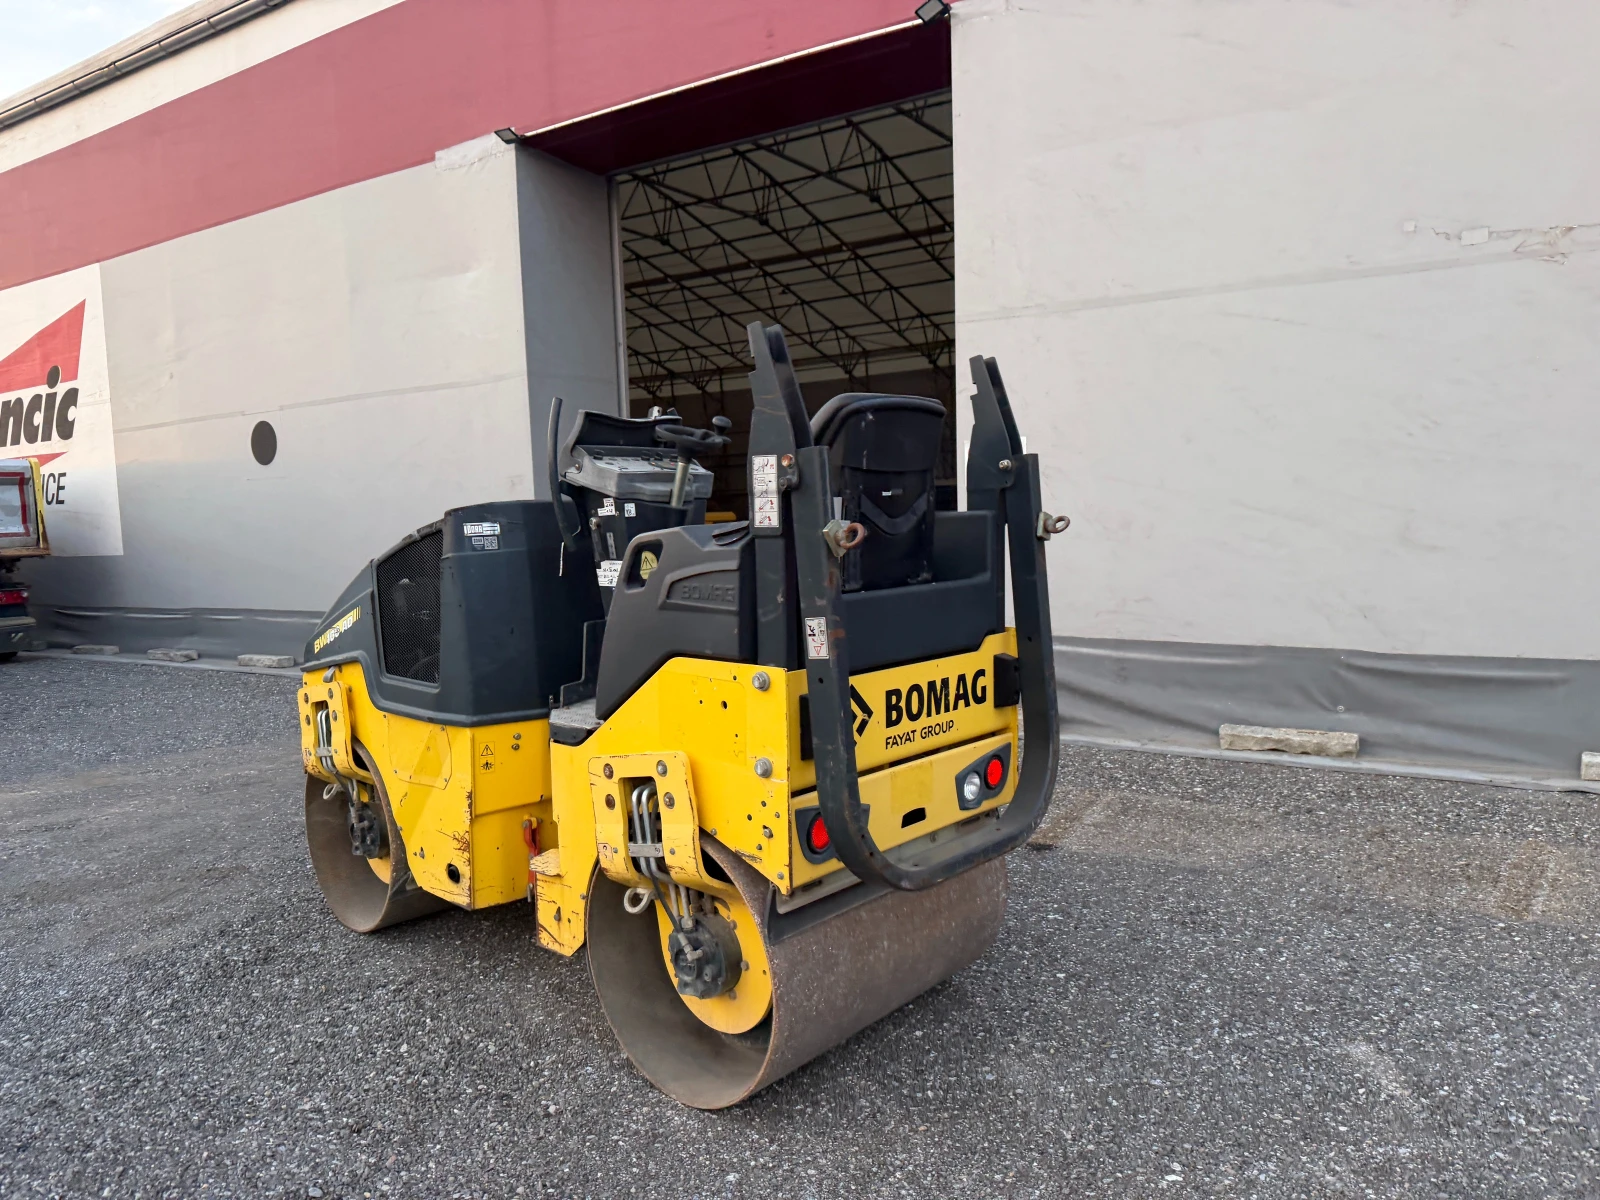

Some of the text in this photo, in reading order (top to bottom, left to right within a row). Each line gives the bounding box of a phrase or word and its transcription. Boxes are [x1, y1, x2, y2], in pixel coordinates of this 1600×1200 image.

[41, 472, 66, 505] ICE
[681, 584, 735, 602] BOMAG
[885, 668, 987, 729] BOMAG
[885, 719, 955, 750] FAYAT GROUP
